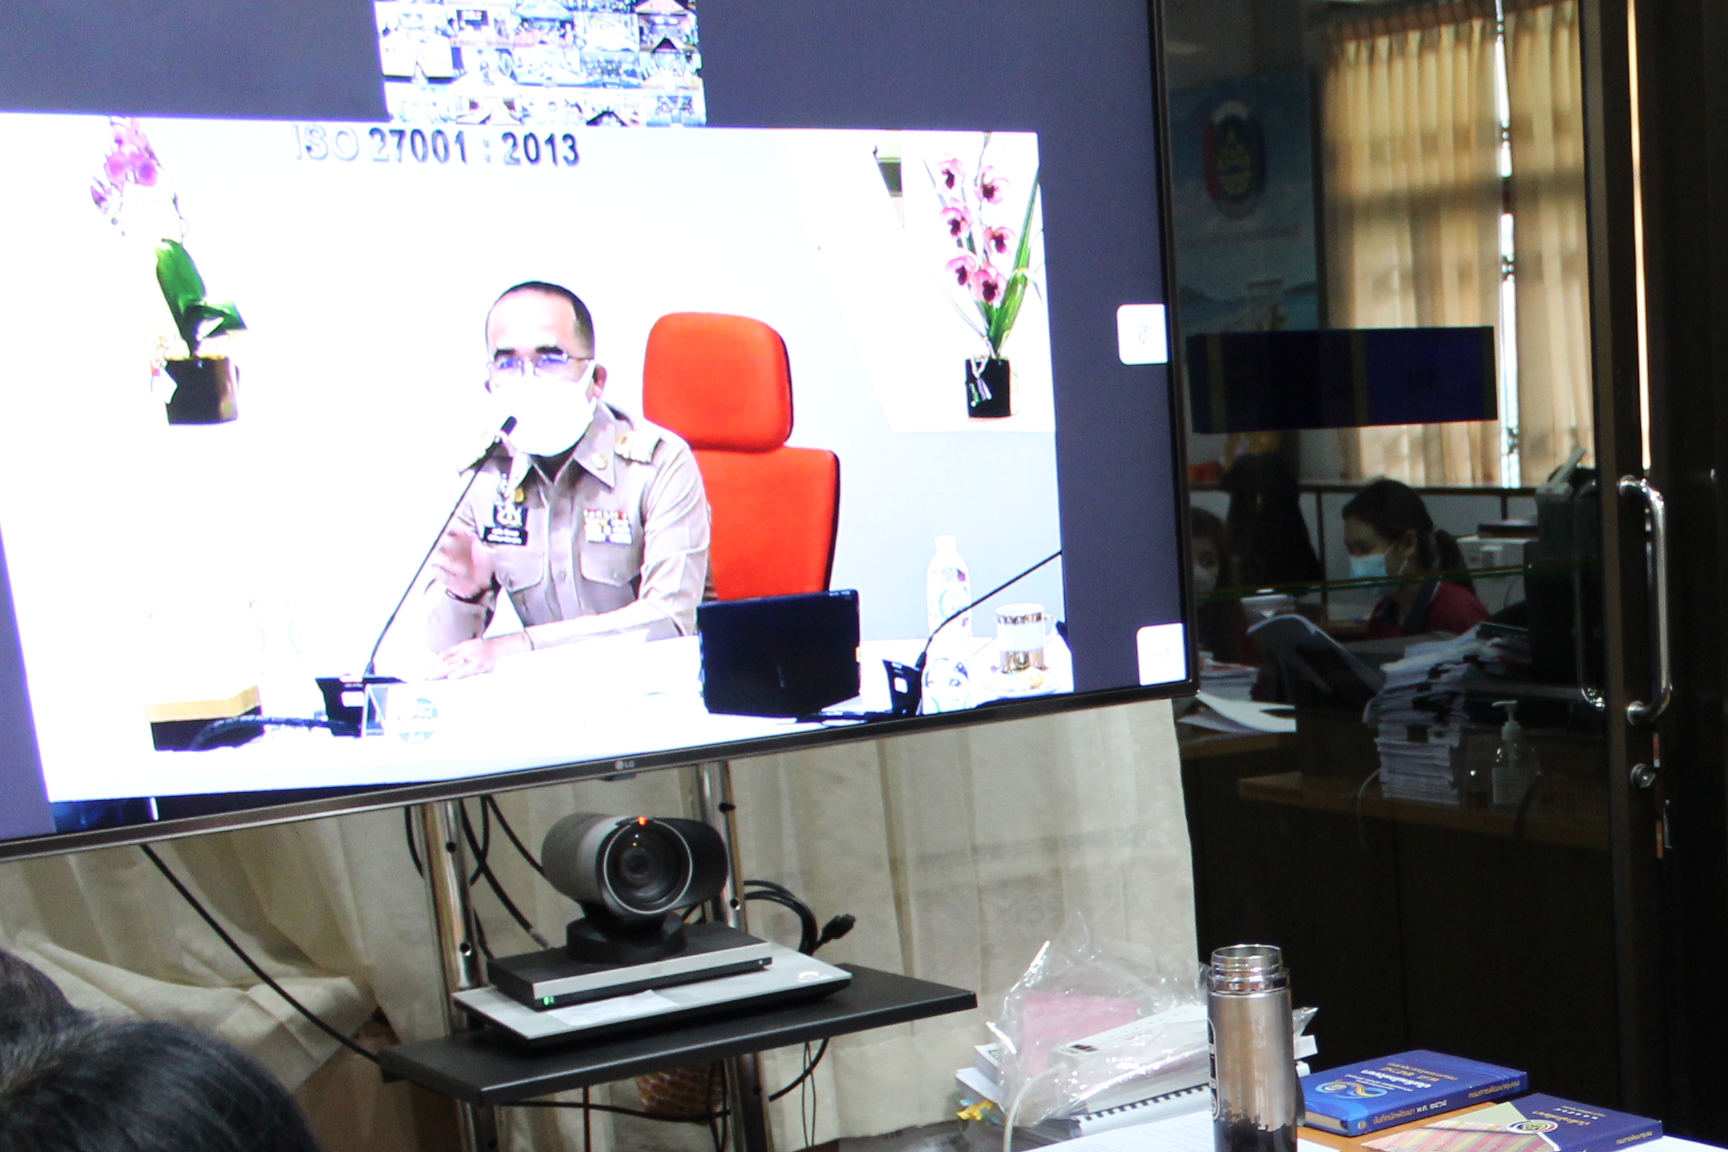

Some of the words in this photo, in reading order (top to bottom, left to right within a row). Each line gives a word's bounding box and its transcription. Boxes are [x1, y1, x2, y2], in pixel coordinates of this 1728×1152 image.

[293, 124, 359, 160] ISO
[369, 127, 467, 164] 27001
[502, 131, 580, 166] 2013
